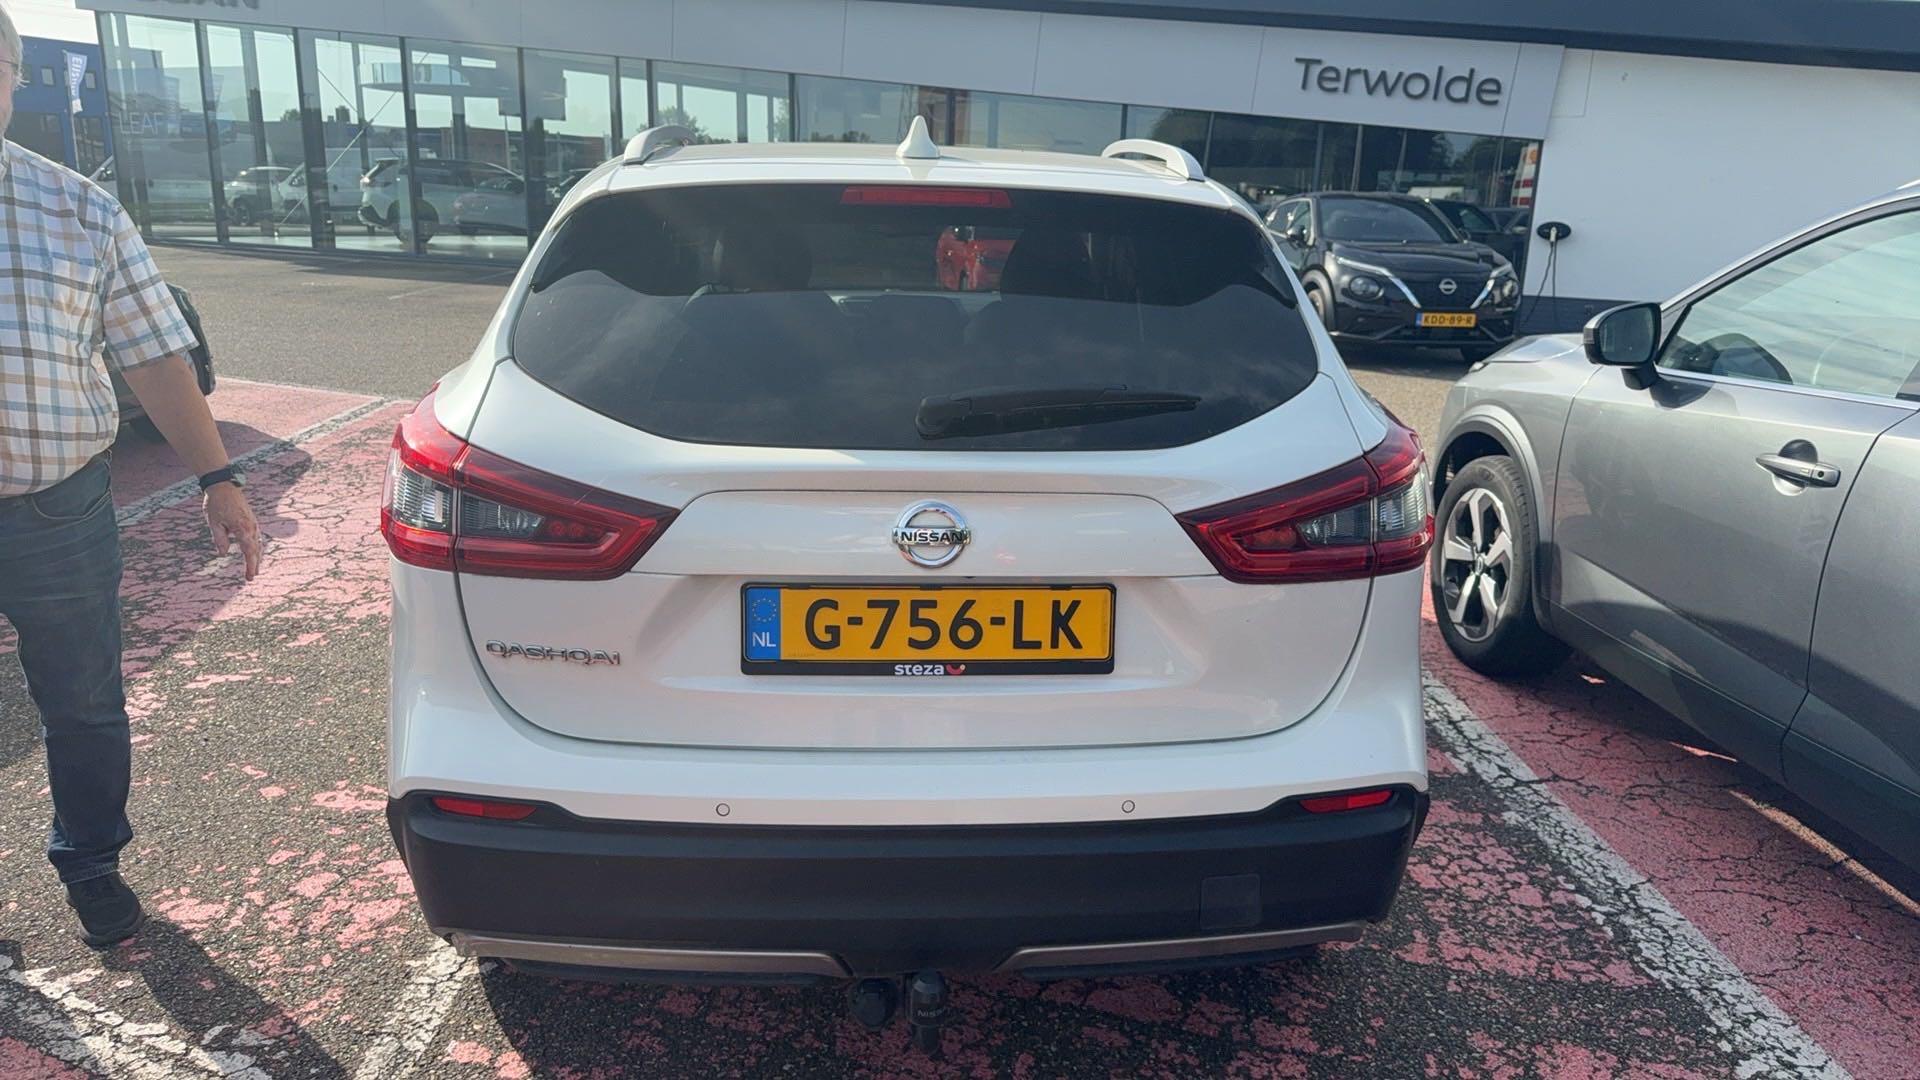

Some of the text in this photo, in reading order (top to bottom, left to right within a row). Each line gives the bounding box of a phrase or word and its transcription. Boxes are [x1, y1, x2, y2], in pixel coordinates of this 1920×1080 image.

[1295, 57, 1502, 106] Terwolde
[901, 531, 963, 542] NISSAN
[804, 598, 1083, 651] G-756-LK
[752, 631, 776, 648] NL
[486, 639, 621, 666] QASHQAI
[894, 663, 945, 676] steza
